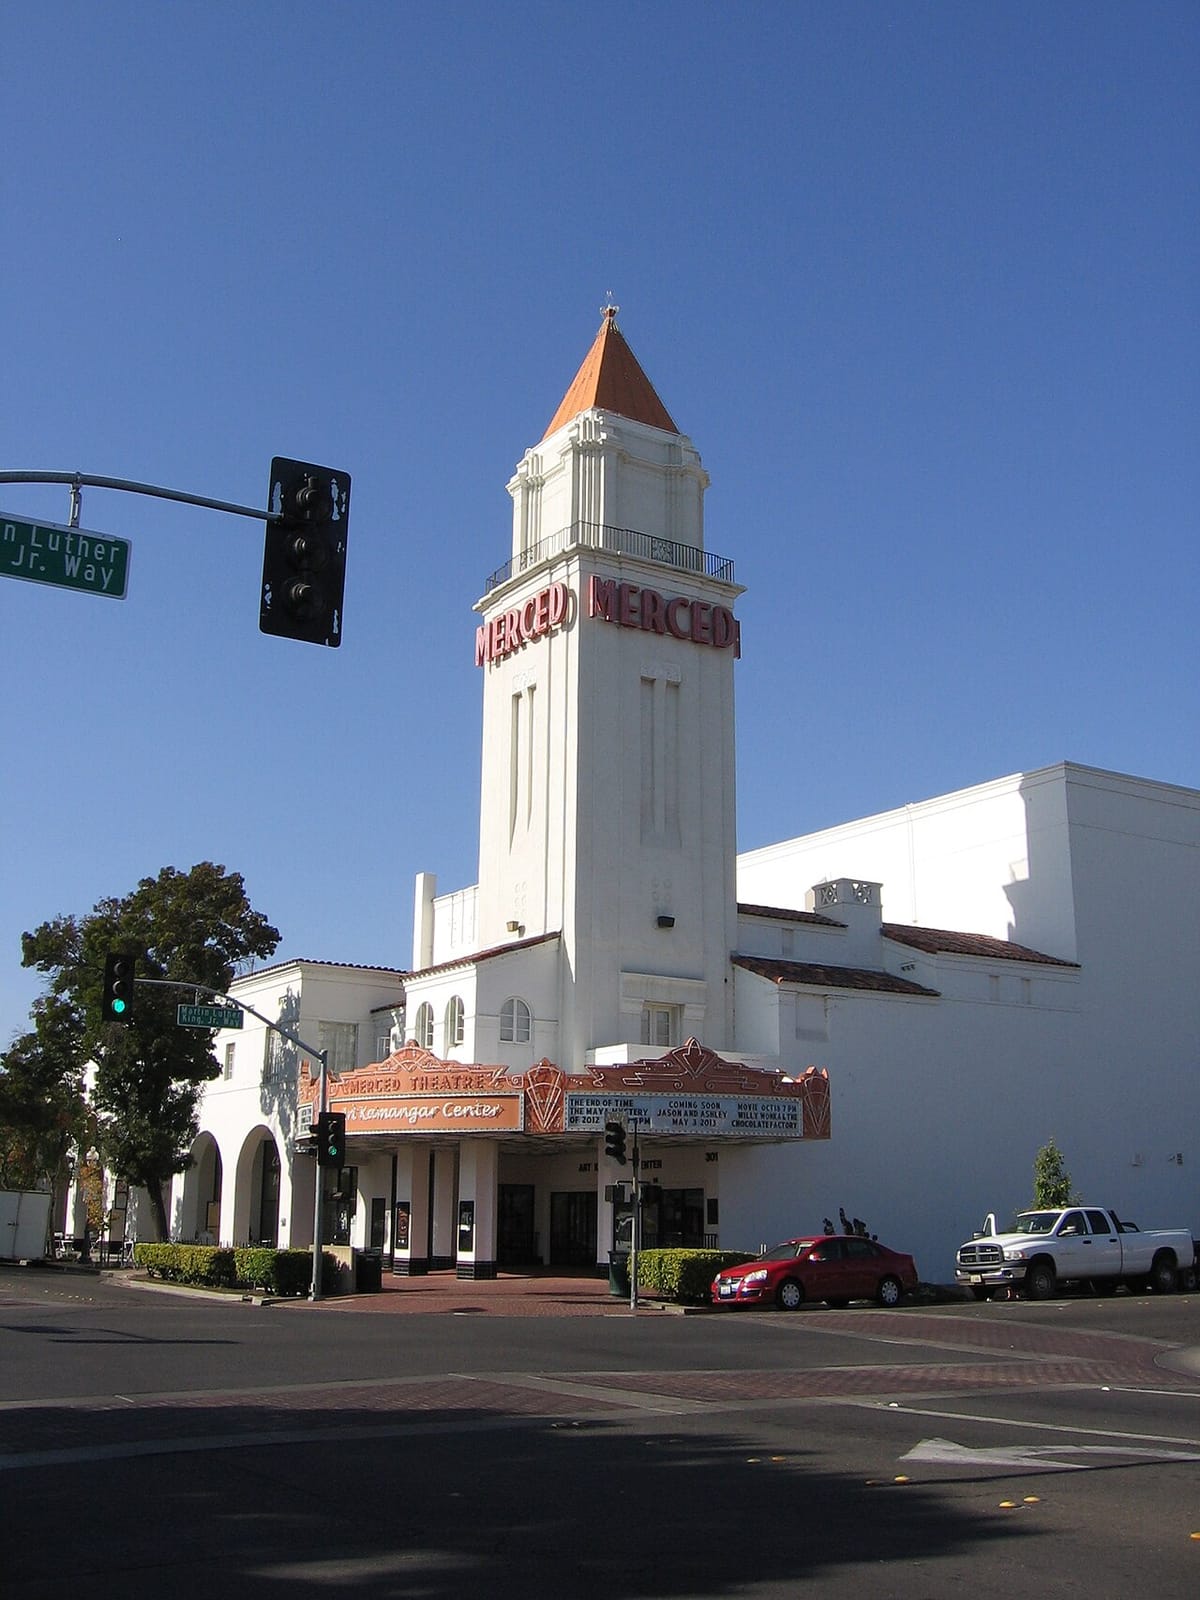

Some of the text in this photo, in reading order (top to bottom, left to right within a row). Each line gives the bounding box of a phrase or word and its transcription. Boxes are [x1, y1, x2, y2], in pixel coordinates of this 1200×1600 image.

[30, 526, 120, 563] Luther
[11, 544, 114, 590] Jr. Way
[589, 575, 738, 649] MERCED
[474, 582, 569, 667] MERCED
[181, 1006, 241, 1019] Martin Luther
[350, 1074, 485, 1094] MERCED THEATRE
[570, 1098, 634, 1107] THE END OF TIME
[668, 1101, 720, 1110] COMING SOON
[359, 1104, 440, 1124] Kamangar
[442, 1100, 501, 1118] Center
[570, 1107, 584, 1115] THE
[657, 1109, 682, 1117] JASON
[700, 1110, 727, 1118] ASHLEY
[737, 1111, 758, 1119] WILLY
[570, 1116, 579, 1124] OF
[582, 1116, 600, 1124] 2012
[672, 1118, 688, 1126] MAY
[705, 1152, 719, 1162] 301
[578, 1163, 591, 1172] ART
[640, 1160, 663, 1170] ENTER
